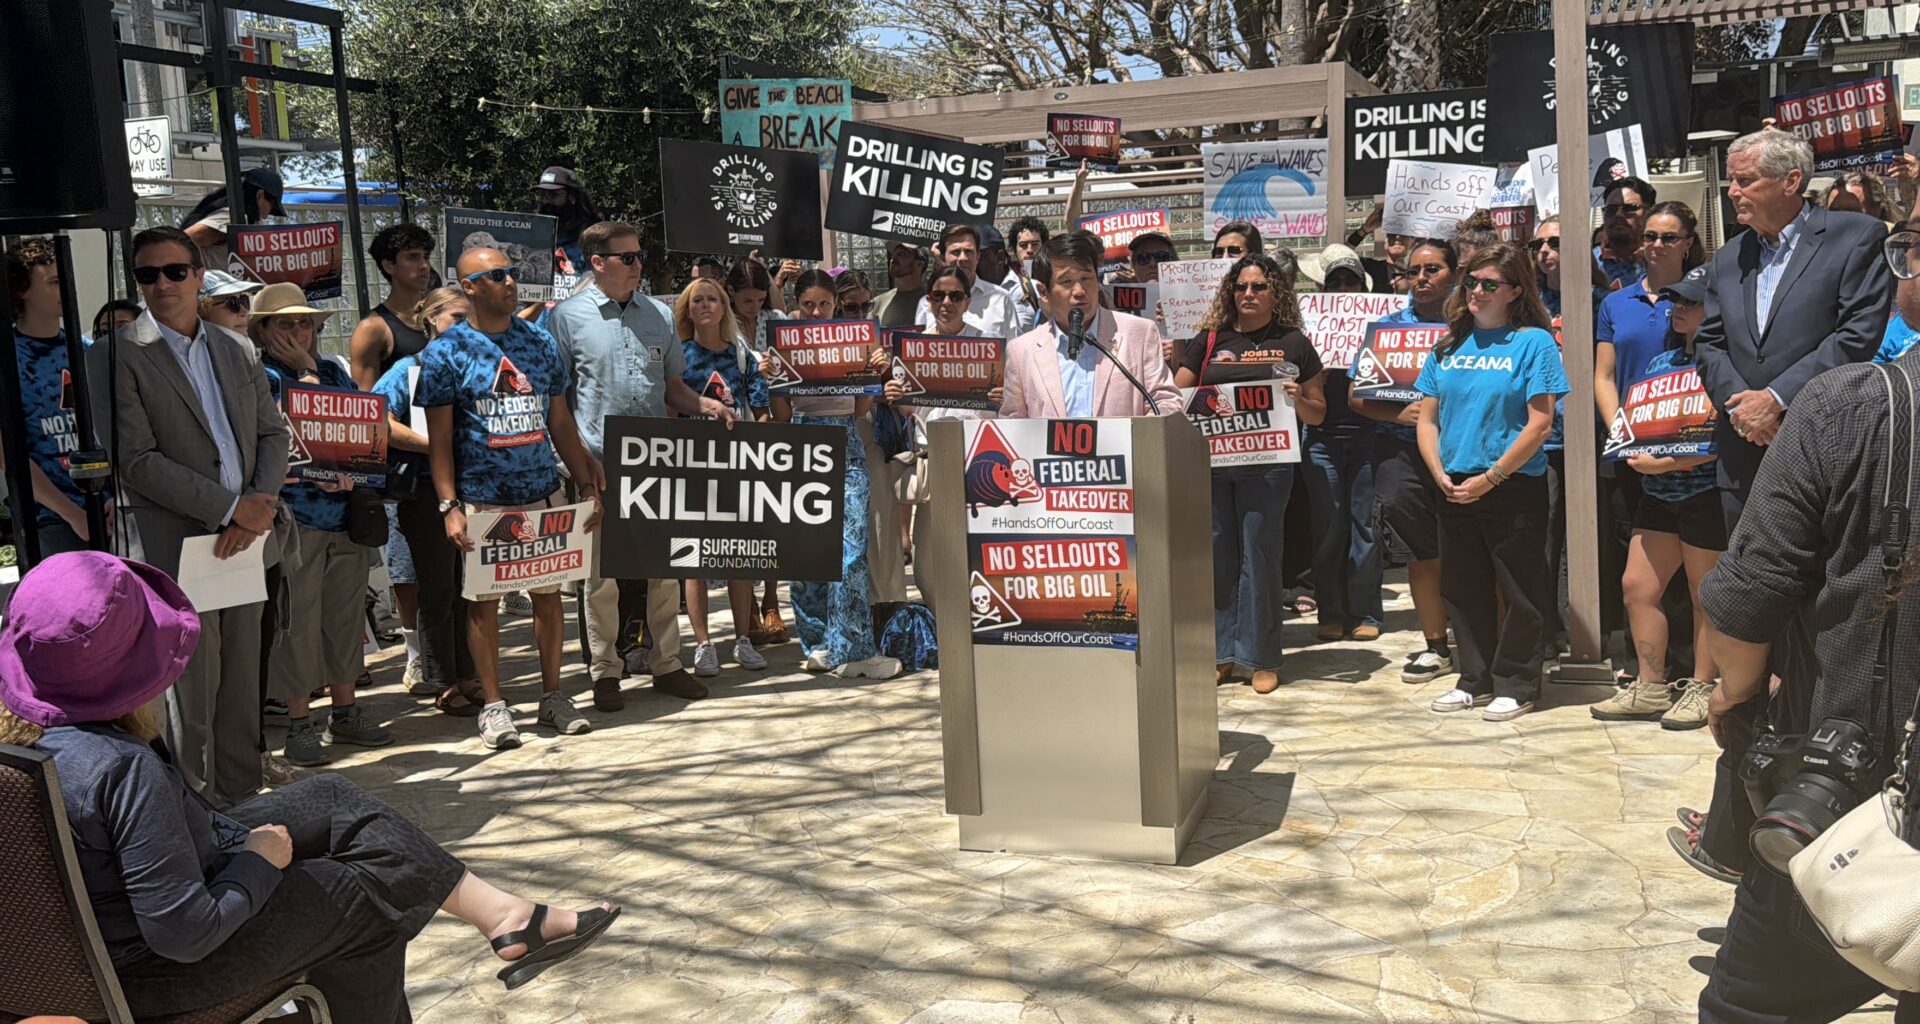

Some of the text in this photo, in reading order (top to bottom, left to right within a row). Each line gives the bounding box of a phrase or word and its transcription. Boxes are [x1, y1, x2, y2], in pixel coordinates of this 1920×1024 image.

[724, 86, 843, 110] GIVE THE BEACH
[1780, 102, 1802, 122] NO
[1806, 82, 1886, 117] SELLOUTS
[1355, 99, 1486, 128] DRILLING IS
[1793, 109, 1880, 140] FOR BIG OIL
[733, 113, 840, 149] A BREAK
[1056, 118, 1114, 134] NO SELLOUTS
[1062, 134, 1108, 148] FOR BIG OIL
[1355, 124, 1486, 160] KILLING
[150, 158, 166, 172] USE
[848, 136, 994, 181] DRILLING IS
[1209, 152, 1258, 178] SAVE
[1276, 149, 1326, 176] WAVES
[842, 162, 989, 216] KILLING
[1394, 164, 1487, 194] Hands off
[711, 154, 778, 228] DRILLING IS KILLING
[453, 216, 532, 229] DEFEND THE OCEAN
[1085, 212, 1160, 235] NO SELLOUTS
[1284, 213, 1326, 236] WAVES
[243, 227, 334, 252] NO SELLOUTS
[256, 250, 328, 272] FOR BIG OIL
[1160, 262, 1208, 278] PROTECT
[1117, 288, 1142, 308] NO
[780, 328, 799, 346] NO
[804, 325, 870, 344] SELLOUTS
[1379, 332, 1400, 348] NO
[791, 346, 864, 366] FOR BIG OIL
[906, 342, 996, 359] NO SELLOUTS
[1240, 350, 1268, 358] JOBS
[1385, 352, 1410, 368] FOR
[916, 362, 988, 379] FOR BIG OIL
[1440, 355, 1513, 372] OCEANA
[789, 385, 864, 396] #HandsOffOurCoast
[1238, 386, 1269, 410] NO
[1629, 384, 1648, 406] NO
[292, 392, 378, 420] NO SELLOUTS
[476, 395, 544, 416] NO FEDERAL
[912, 397, 988, 409] #HandsOffOurCoast
[1630, 395, 1706, 424] FOR BIG OIL
[40, 416, 64, 436] NO
[300, 420, 370, 444] FOR BIG OIL
[486, 412, 546, 432] TAKEOVER
[1054, 422, 1094, 454] NO
[1208, 434, 1288, 454] TAKEOVER
[620, 436, 834, 473] DRILLING IS
[1212, 454, 1278, 464] andsOffOurCoast
[1040, 458, 1121, 484] FEDERAL
[620, 476, 832, 524] KILLING
[1050, 490, 1129, 510] TAKEOVER
[544, 512, 572, 535] NO
[992, 516, 1114, 530] #HandsOffOurCoast
[486, 536, 564, 562] FEDERAL
[702, 538, 777, 556] SURFRIDER
[988, 542, 1120, 570] NO SELLOUTS
[499, 553, 579, 579] TAKEOVER
[490, 573, 568, 590] #HandsOffOurCoast
[1004, 574, 1112, 600] FOR BIG OIL
[1003, 632, 1114, 644] #HandsOffOurCoast
[1803, 756, 1828, 764] Canon
